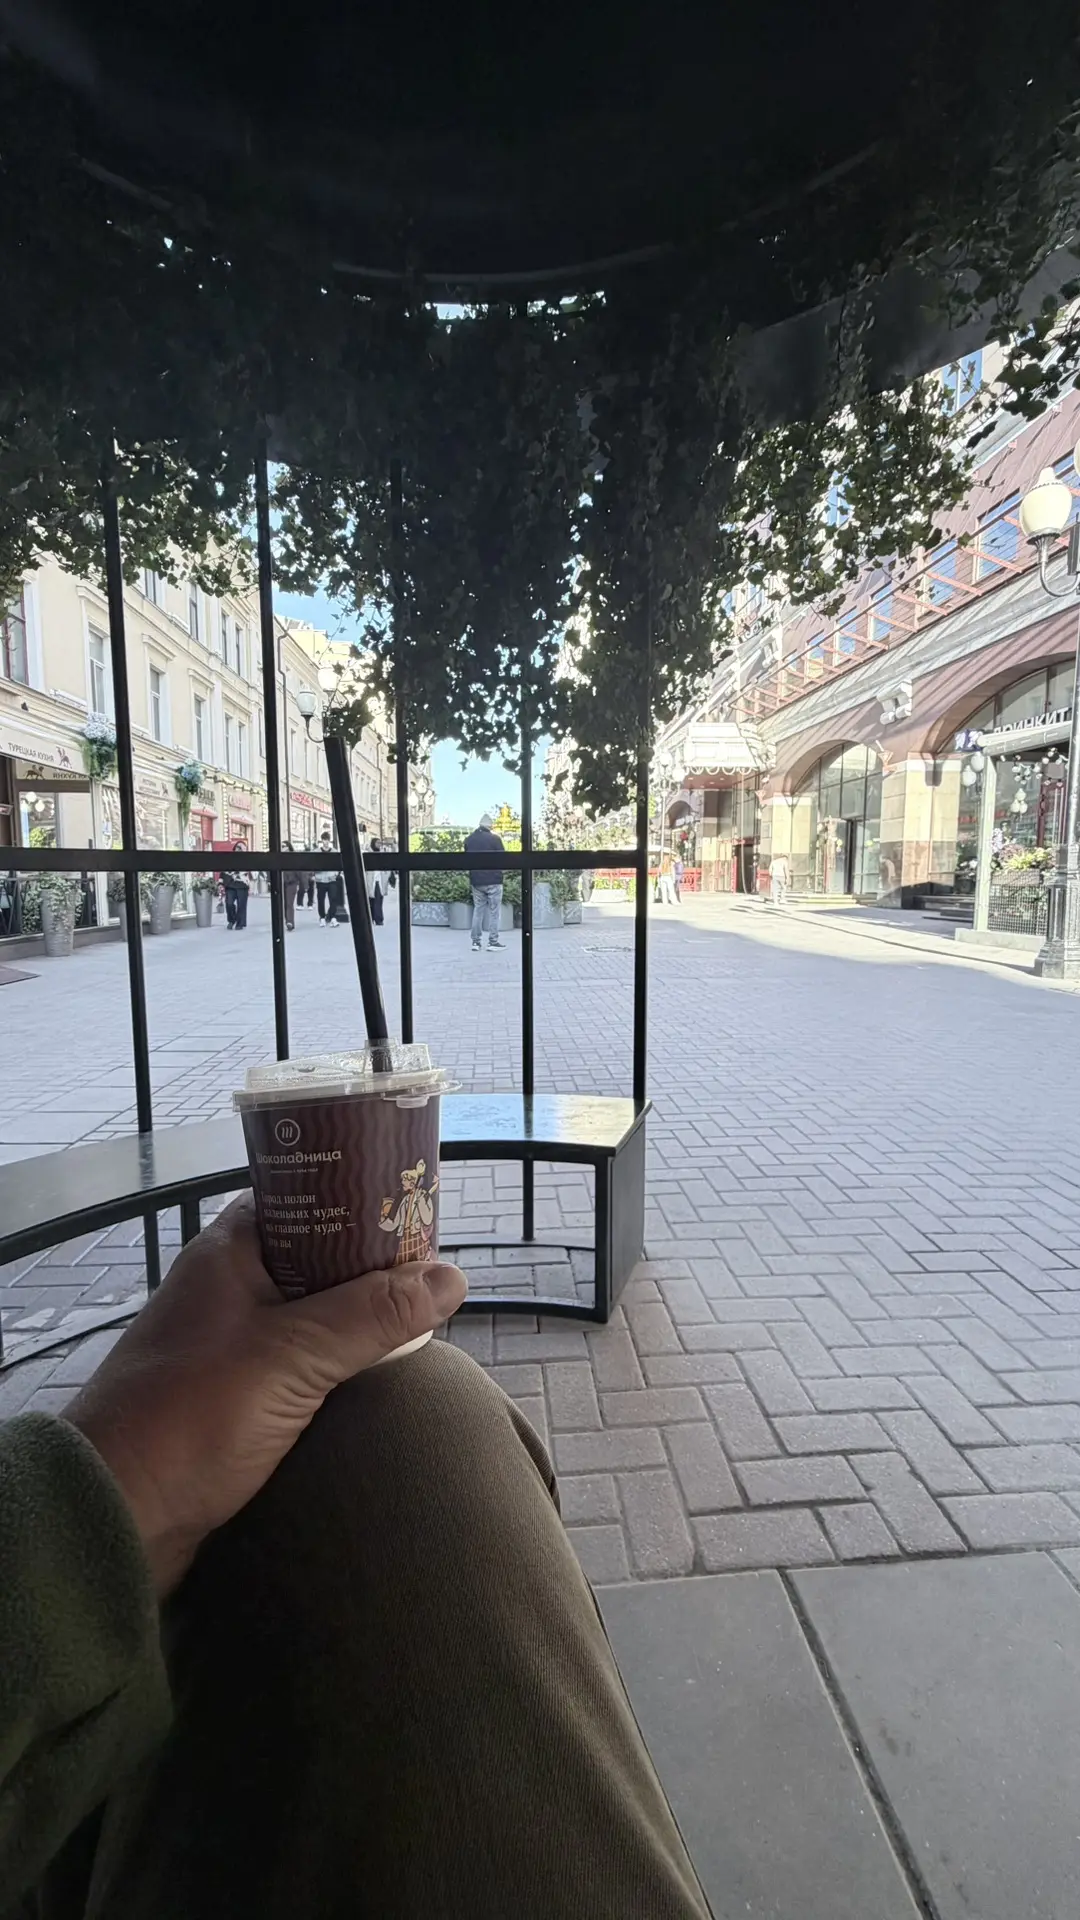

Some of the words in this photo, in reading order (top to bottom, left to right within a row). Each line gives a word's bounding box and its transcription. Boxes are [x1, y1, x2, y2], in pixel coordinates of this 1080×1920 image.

[8, 742, 37, 758] ТУРЕЦКАЯ
[38, 751, 55, 762] КУХНЯ
[256, 1150, 342, 1165] Шоколадница
[284, 1194, 316, 1205] полон
[313, 1206, 350, 1221] чудес,
[275, 1224, 311, 1235] главное
[314, 1222, 342, 1236] чудо
[279, 1239, 292, 1248] вы
